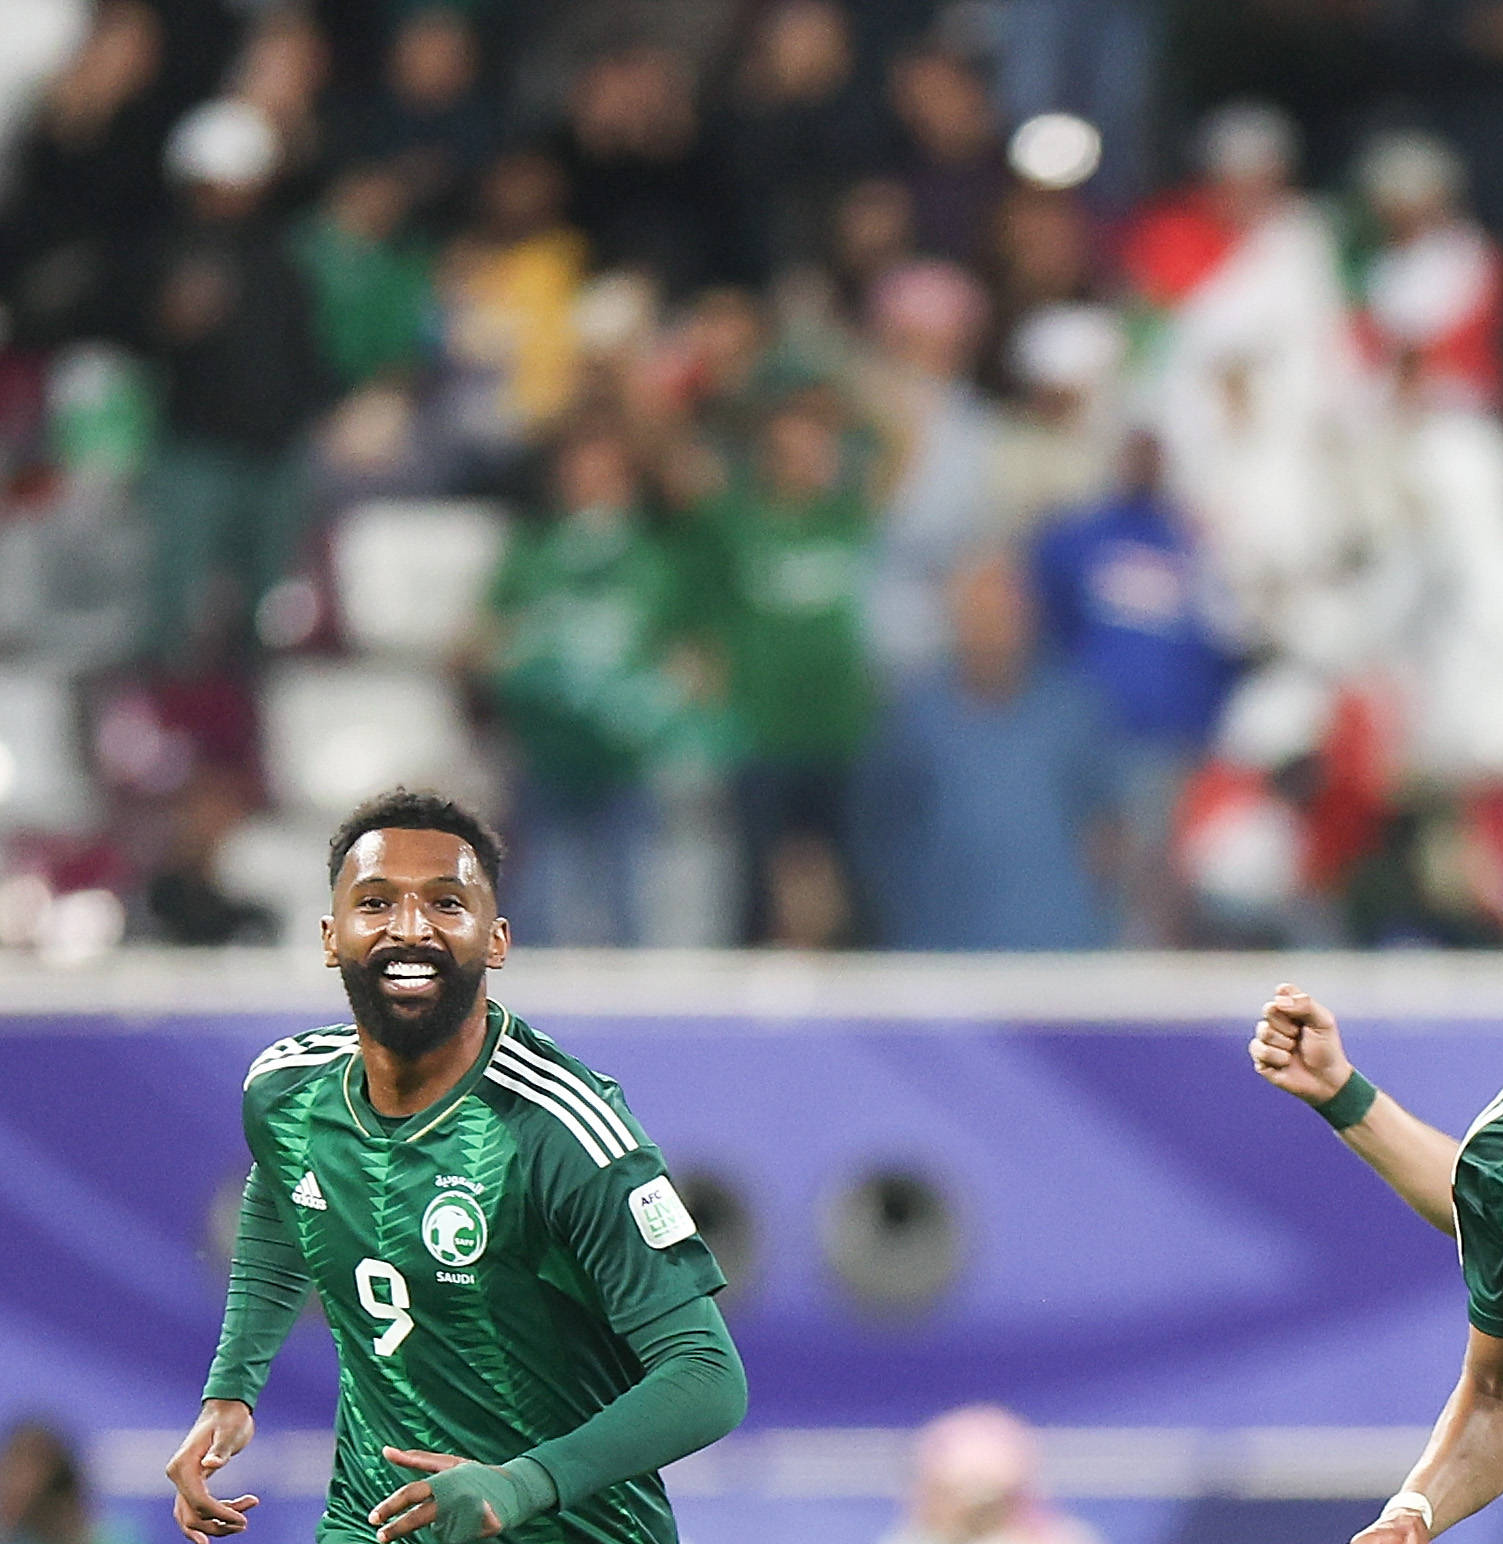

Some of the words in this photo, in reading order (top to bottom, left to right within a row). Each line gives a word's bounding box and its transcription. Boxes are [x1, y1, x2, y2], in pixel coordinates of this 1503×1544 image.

[641, 1189, 662, 1207] AFC
[435, 1271, 475, 1285] SAUDI
[353, 1256, 415, 1357] 9
